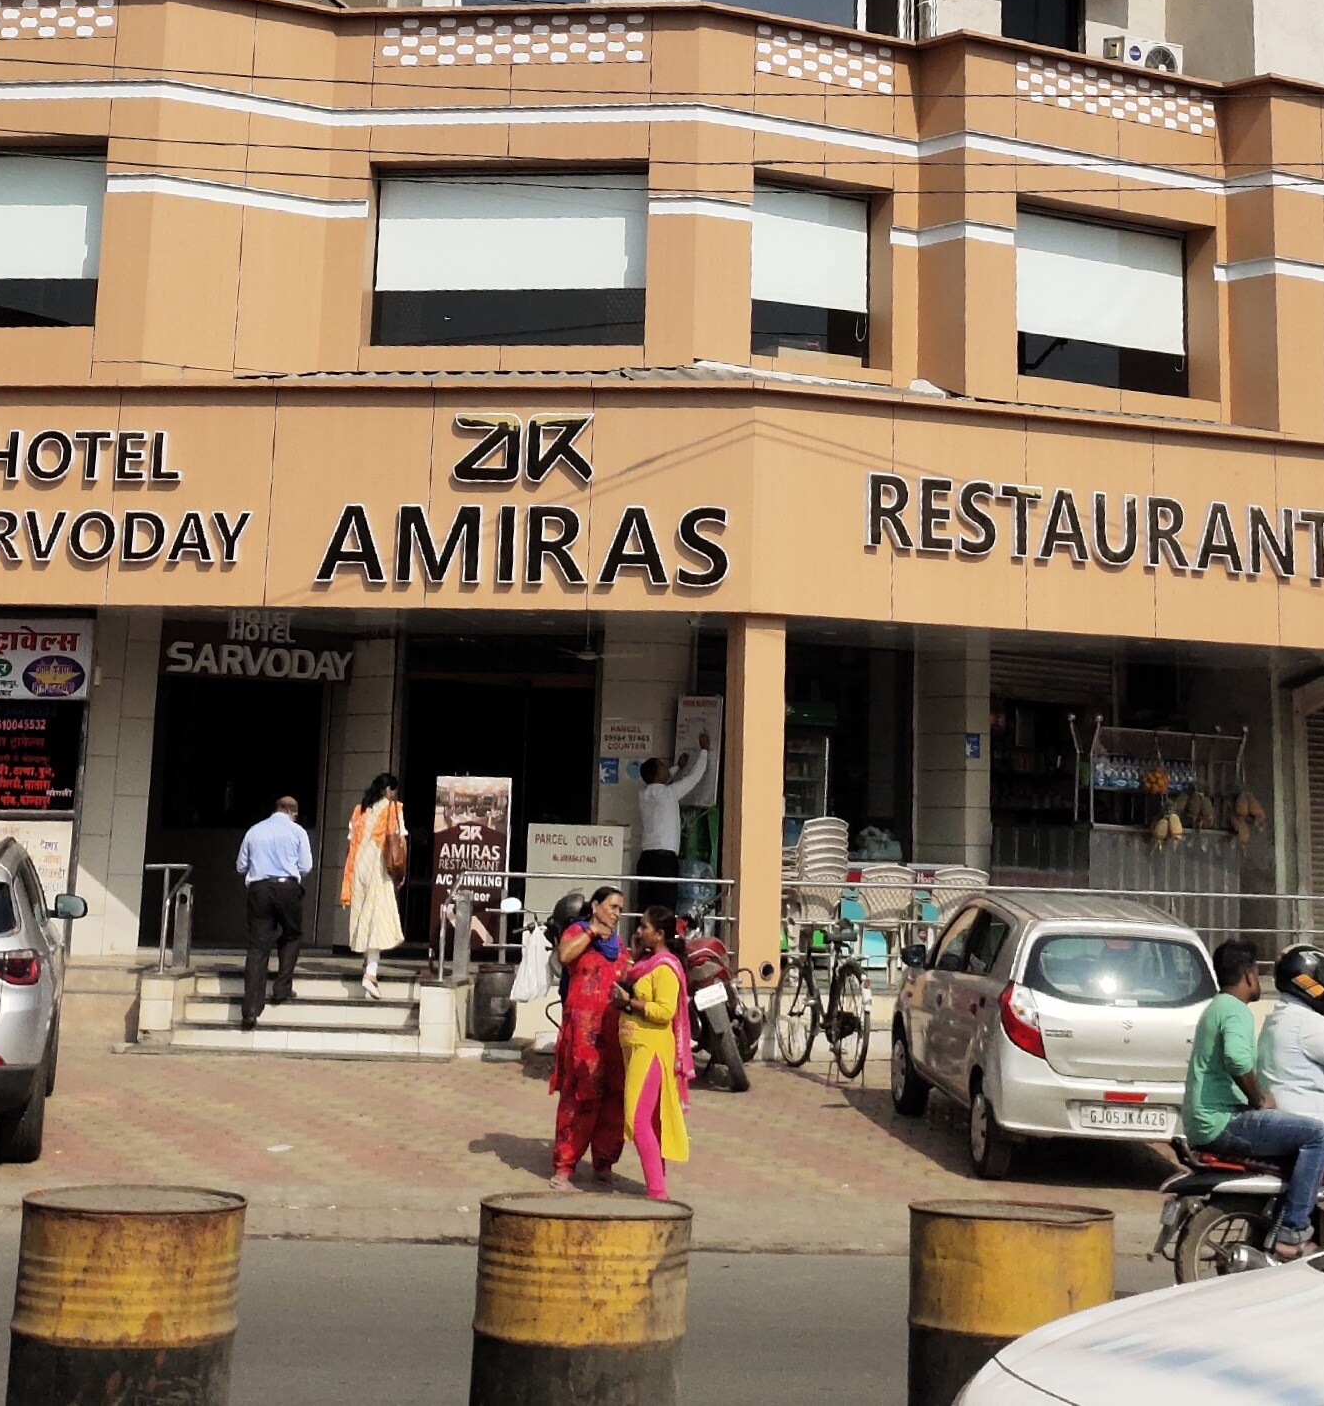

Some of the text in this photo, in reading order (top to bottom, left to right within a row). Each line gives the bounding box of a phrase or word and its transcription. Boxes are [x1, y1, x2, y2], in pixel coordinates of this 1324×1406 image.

[313, 503, 730, 588] AMIRAS
[226, 622, 298, 644] HOTEL
[165, 641, 354, 681] SARVODAY
[610, 725, 641, 734] PARCEL
[607, 742, 646, 751] COUNTER
[535, 834, 614, 847] PARCEL COUNTER
[439, 843, 501, 861] AMIRAS
[438, 859, 500, 871] RESTAURANT
[435, 874, 453, 885] A/C
